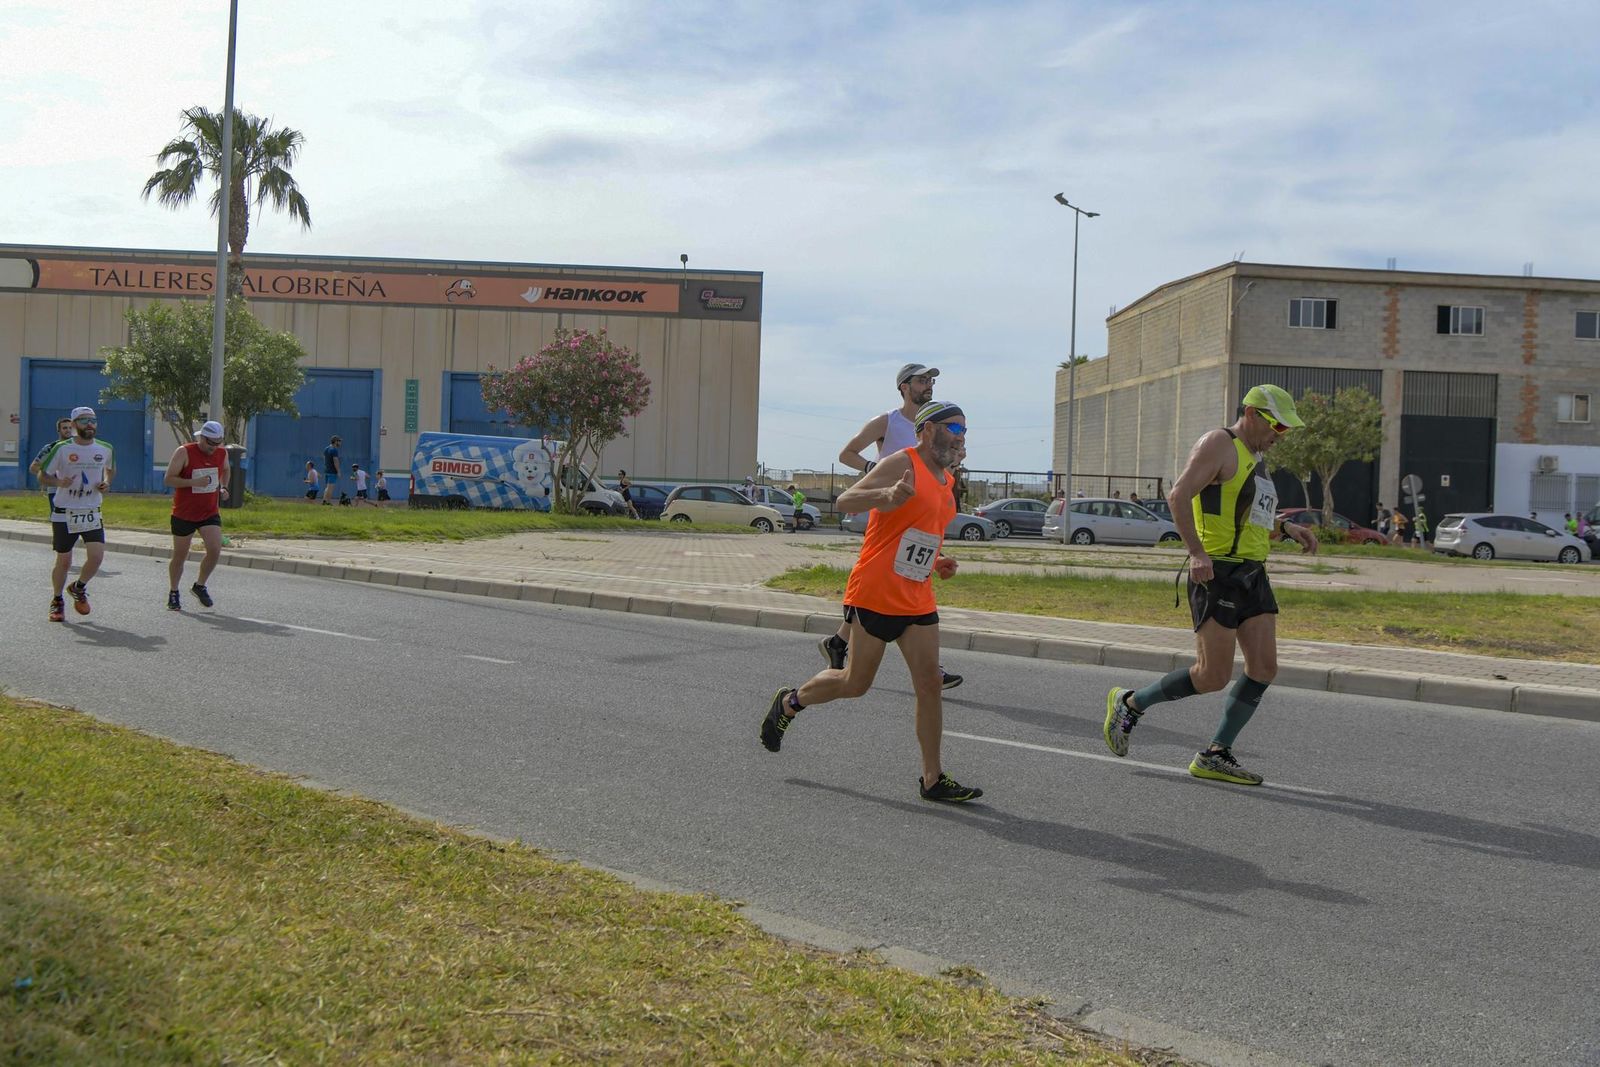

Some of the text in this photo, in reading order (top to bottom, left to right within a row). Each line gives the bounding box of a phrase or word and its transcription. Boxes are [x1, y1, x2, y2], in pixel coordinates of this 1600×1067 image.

[89, 268, 387, 298] TALLERES ALOBREÑA
[432, 460, 483, 475] BIMBO
[72, 513, 95, 524] 770
[905, 544, 934, 566] 157
